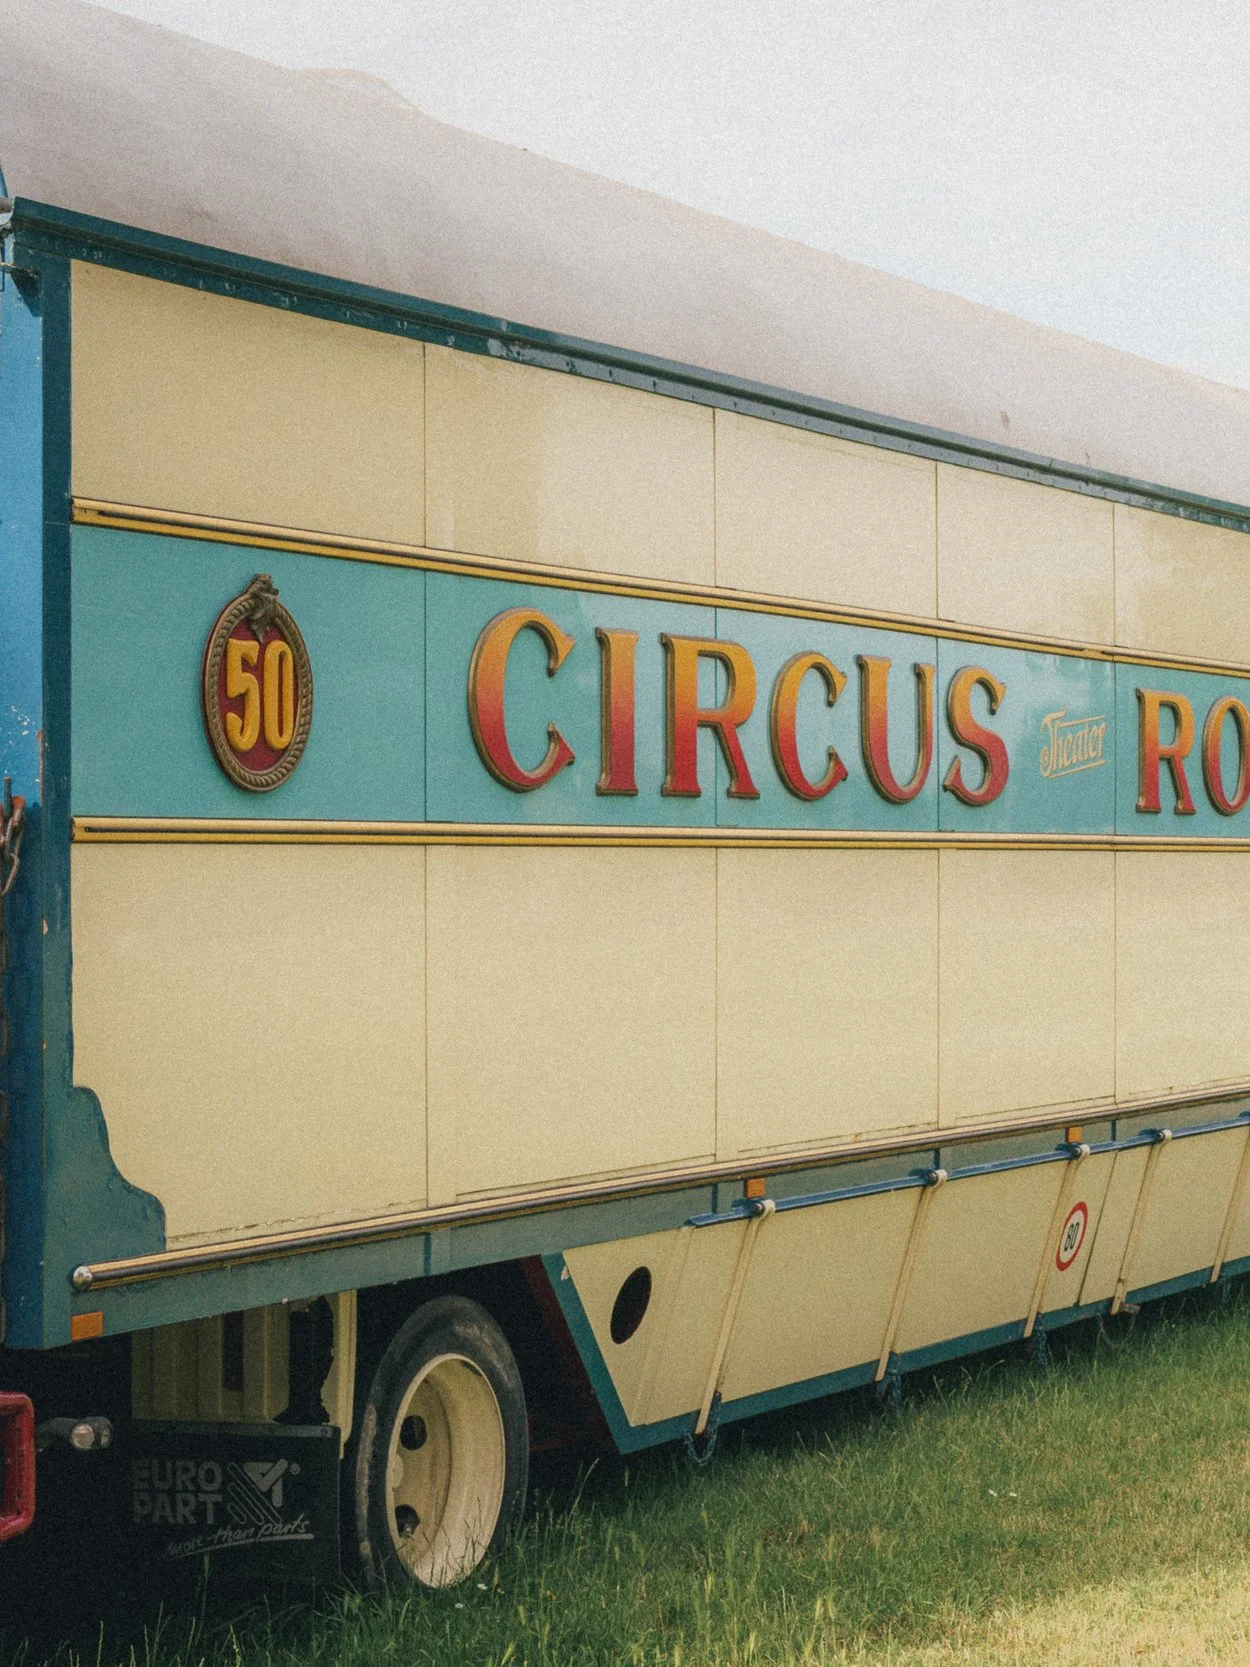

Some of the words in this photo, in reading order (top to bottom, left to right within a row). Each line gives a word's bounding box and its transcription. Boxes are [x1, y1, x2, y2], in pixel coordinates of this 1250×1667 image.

[225, 638, 296, 753] 50
[467, 606, 1010, 807] CIRCUS
[1040, 704, 1106, 777] Theater
[1064, 1221, 1080, 1252] 80
[131, 1458, 223, 1491] EURO
[131, 1492, 223, 1524] PART
[208, 1526, 255, 1544] than
[256, 1512, 310, 1543] parts
